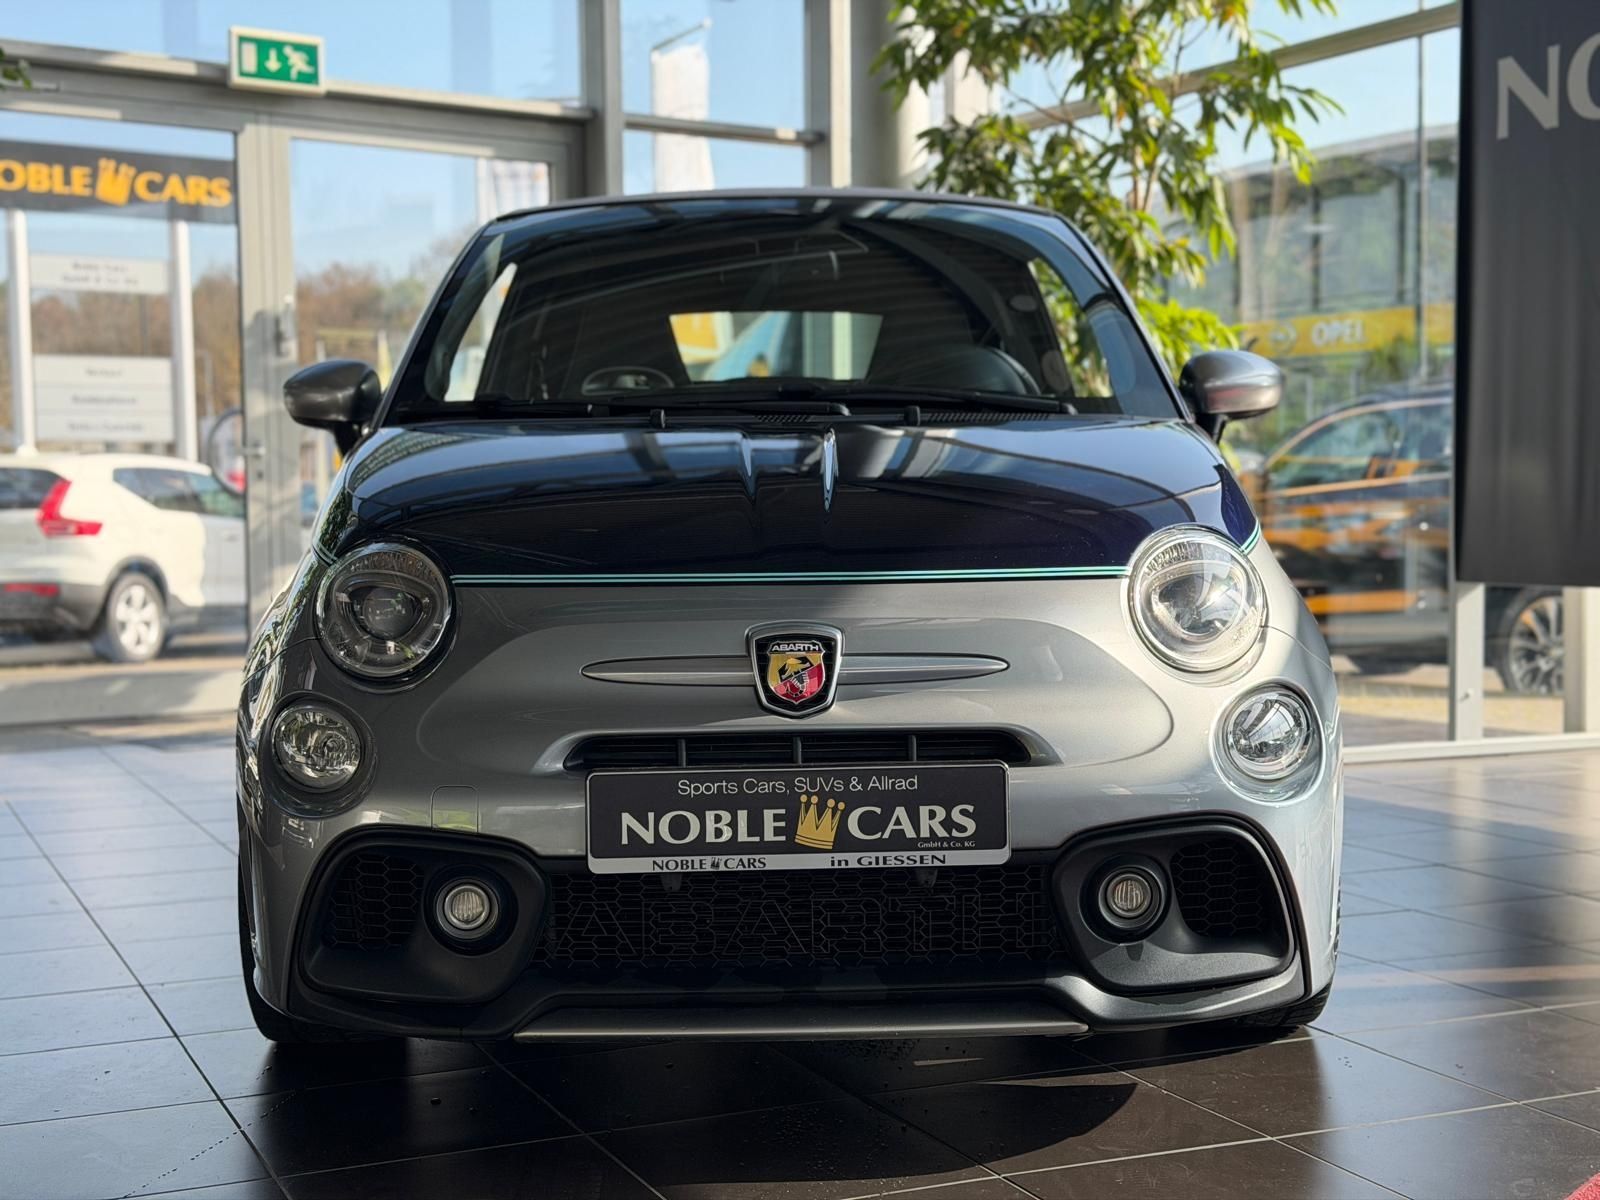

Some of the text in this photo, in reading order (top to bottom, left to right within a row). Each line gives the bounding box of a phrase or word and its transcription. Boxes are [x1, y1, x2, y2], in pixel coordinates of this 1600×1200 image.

[134, 168, 233, 208] CARS
[1312, 320, 1367, 347] OPEL
[771, 643, 819, 652] ABARTH
[677, 775, 918, 798] Sports Cars, SUVs & Allrad
[621, 804, 977, 845] NOBLE CARS
[917, 841, 941, 849] GmbH
[950, 840, 963, 848] Co.
[652, 857, 767, 871] NOBLE CARS
[830, 854, 947, 868] in GIESSEN
[557, 893, 1036, 956] ABARTH
